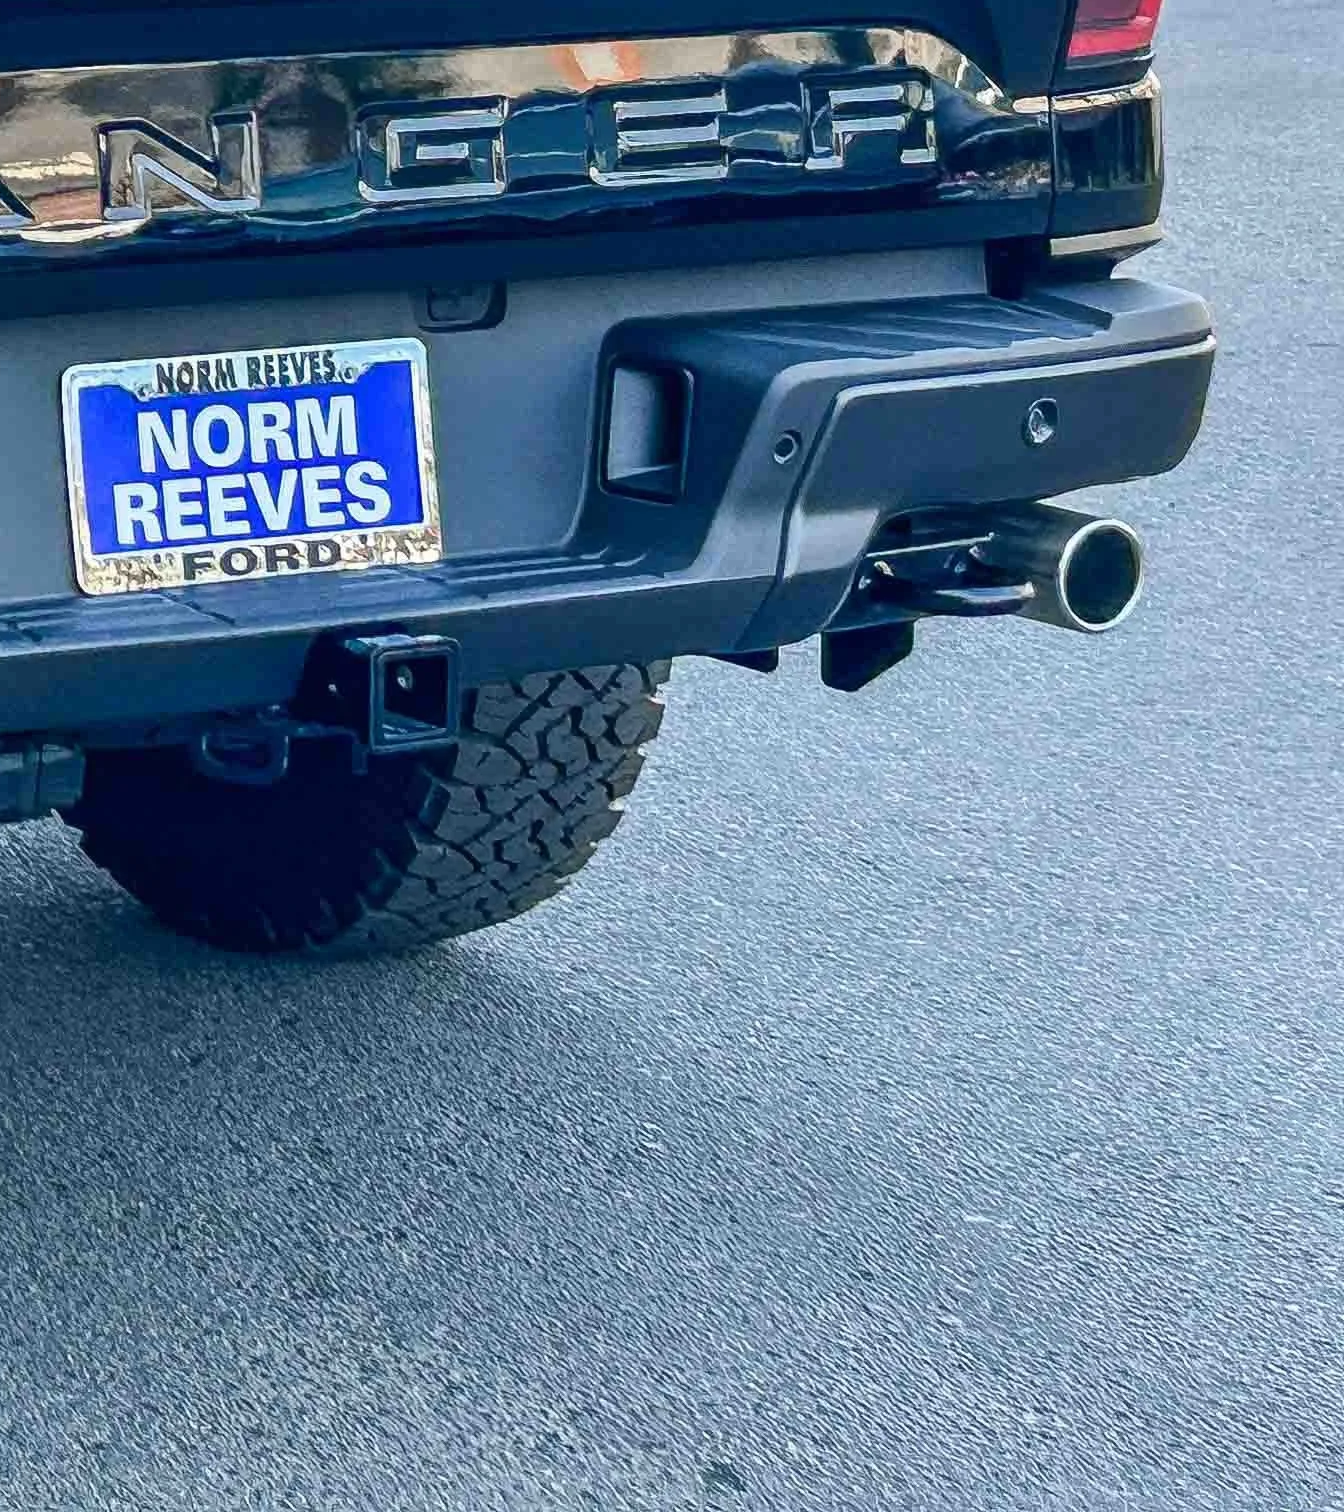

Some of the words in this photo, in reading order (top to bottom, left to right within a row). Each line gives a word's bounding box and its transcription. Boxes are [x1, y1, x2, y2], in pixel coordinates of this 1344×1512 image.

[155, 355, 239, 395] NORM
[246, 349, 337, 389] REEVES
[136, 395, 359, 474] NORM
[113, 461, 392, 545] REEVES
[182, 538, 342, 581] FORD
